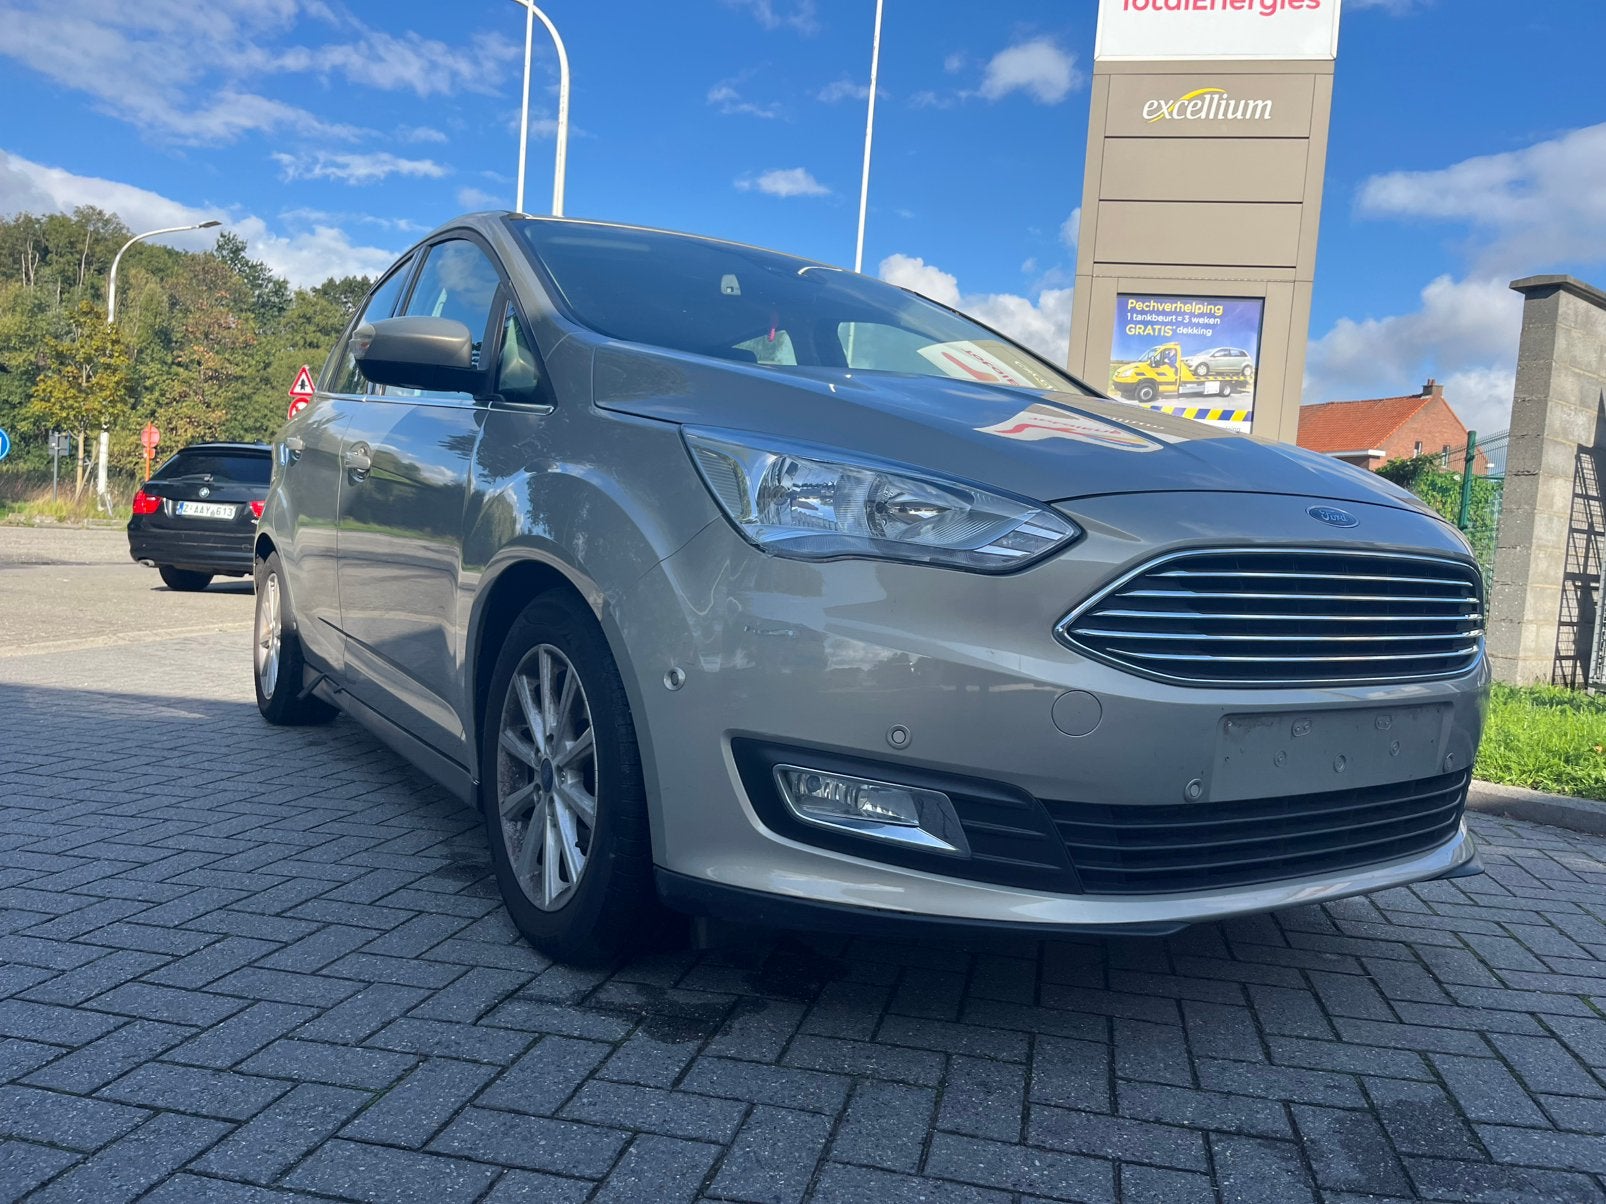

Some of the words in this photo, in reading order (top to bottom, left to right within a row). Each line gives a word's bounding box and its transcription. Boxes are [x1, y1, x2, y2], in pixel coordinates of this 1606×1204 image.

[1122, 0, 1321, 17] otalEnergies
[1142, 93, 1273, 120] excellium
[1127, 299, 1224, 316] Pechverhelping
[1126, 312, 1131, 320] 1
[1133, 313, 1176, 323] tankbeurt
[1183, 315, 1190, 323] 3
[1191, 316, 1221, 325] weken
[1176, 326, 1213, 337] dekking
[1319, 509, 1348, 522] Ford
